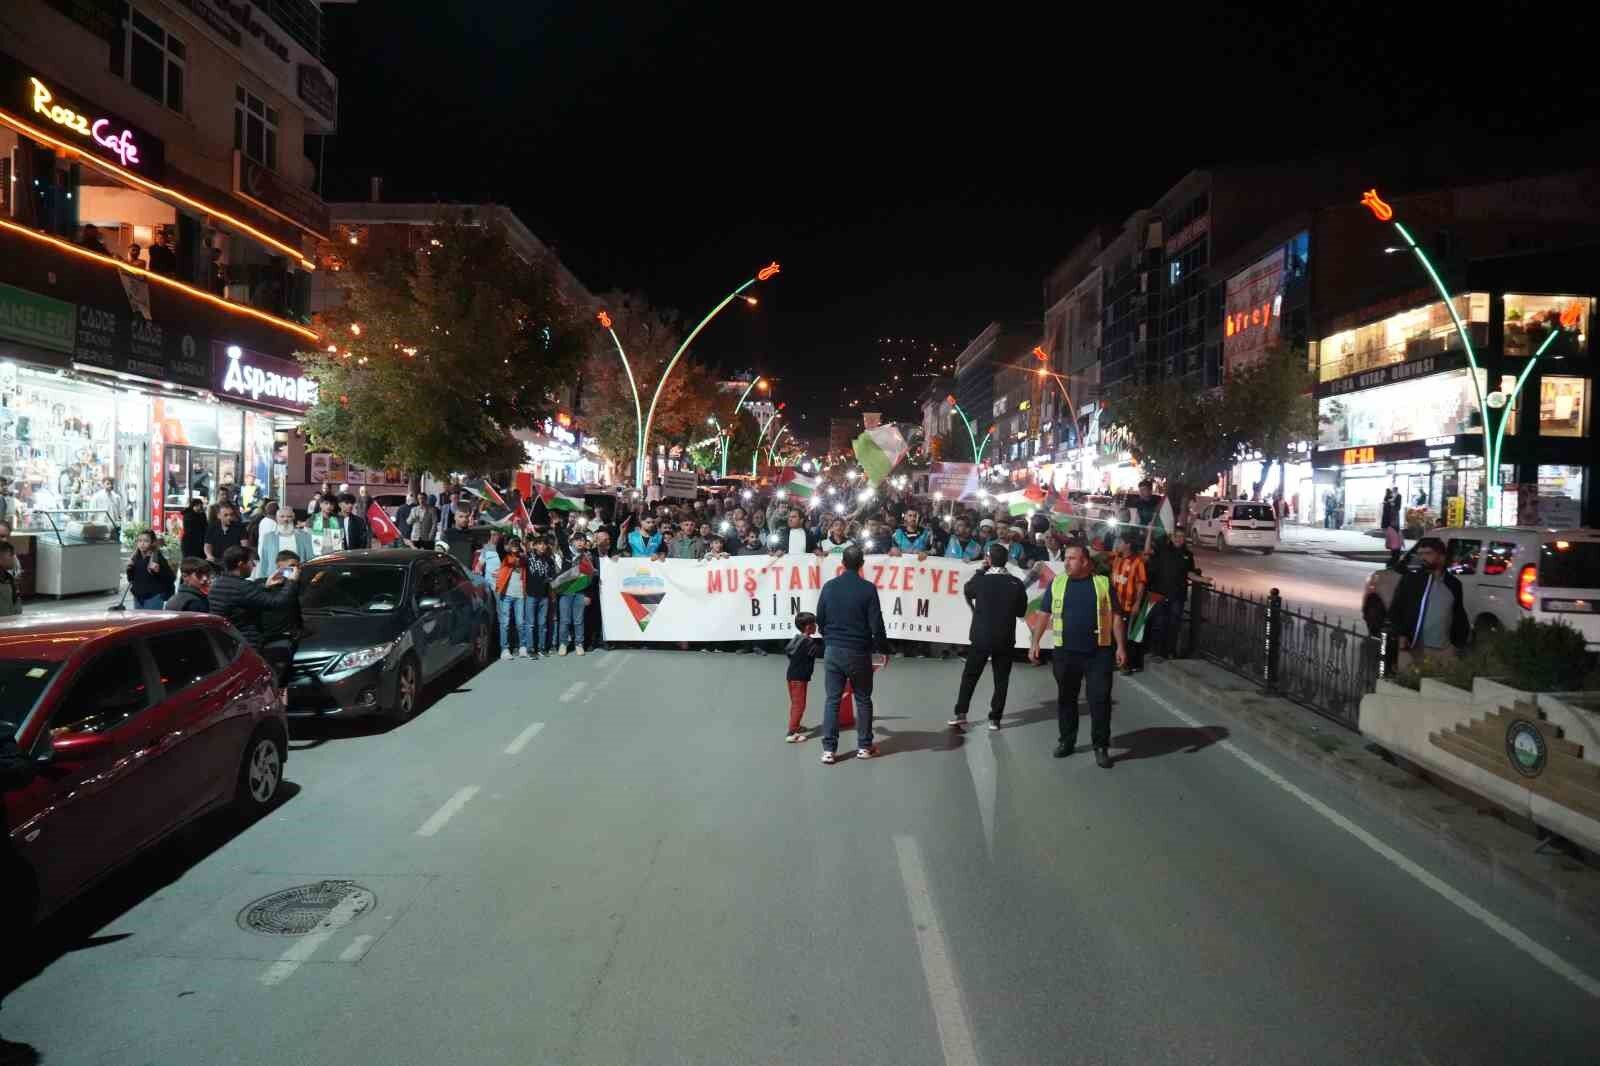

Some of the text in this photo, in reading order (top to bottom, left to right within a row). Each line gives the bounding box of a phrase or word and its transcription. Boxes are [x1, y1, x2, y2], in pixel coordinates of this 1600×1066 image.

[92, 118, 140, 166] Cafe
[836, 564, 960, 595] ZZE'YE
[751, 593, 801, 617] BİN
